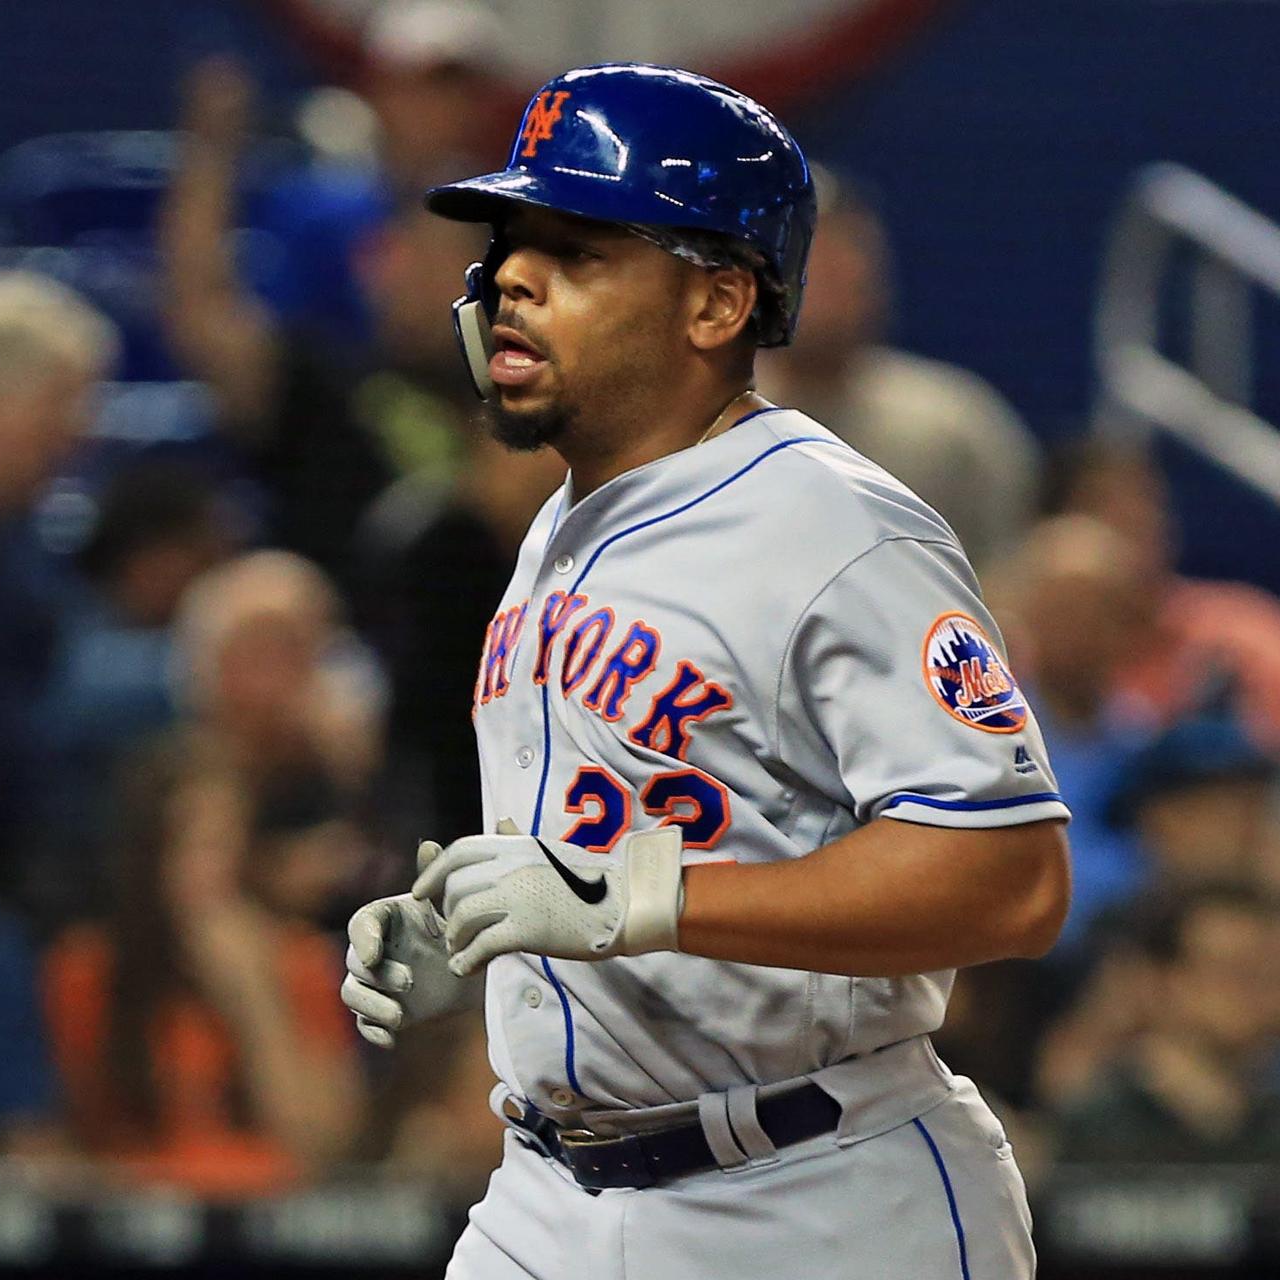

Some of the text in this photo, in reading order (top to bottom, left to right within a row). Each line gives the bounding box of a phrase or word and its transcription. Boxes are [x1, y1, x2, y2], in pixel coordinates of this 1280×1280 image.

[532, 590, 734, 763] YORK
[955, 656, 1013, 707] Mets
[560, 765, 736, 866] 22
